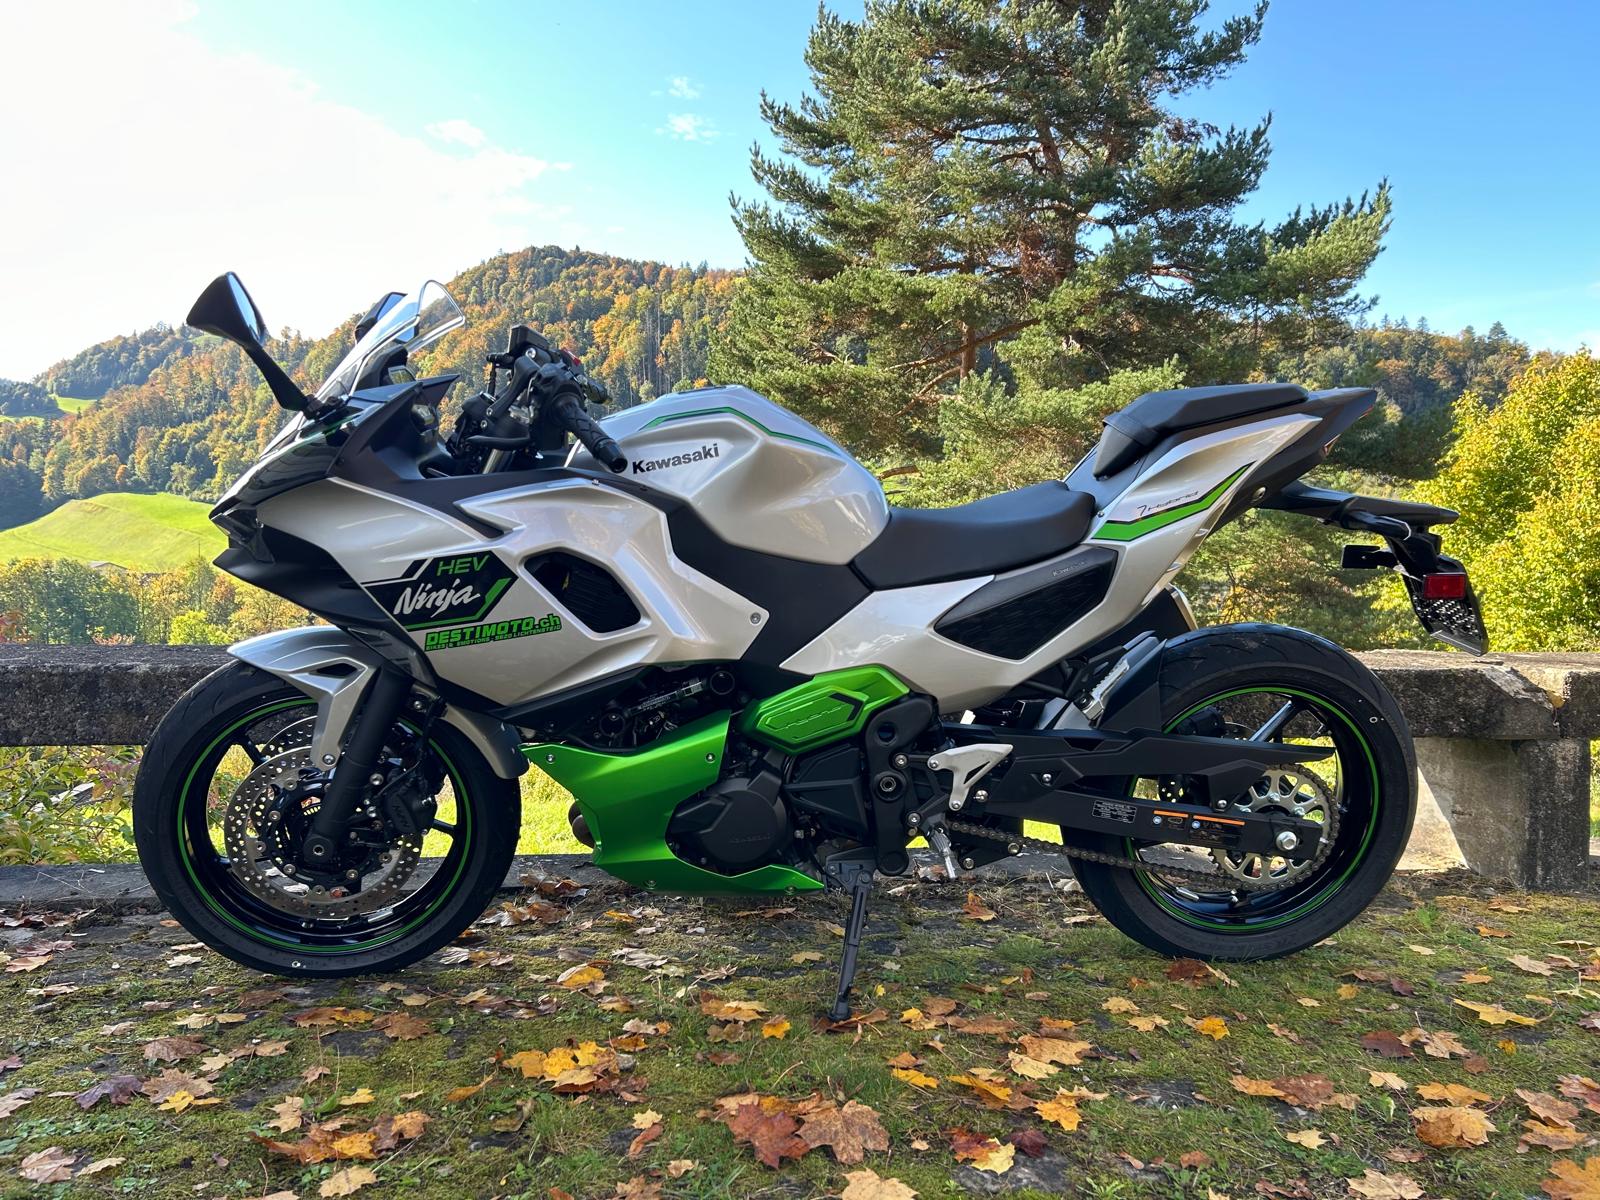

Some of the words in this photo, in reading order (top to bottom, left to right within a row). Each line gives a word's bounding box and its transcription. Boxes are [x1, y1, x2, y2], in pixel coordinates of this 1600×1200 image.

[632, 443, 719, 474] Kawasaki
[437, 554, 490, 576] HEV
[393, 578, 481, 618] Ninja
[427, 614, 561, 646] DESTIMOTO.ch
